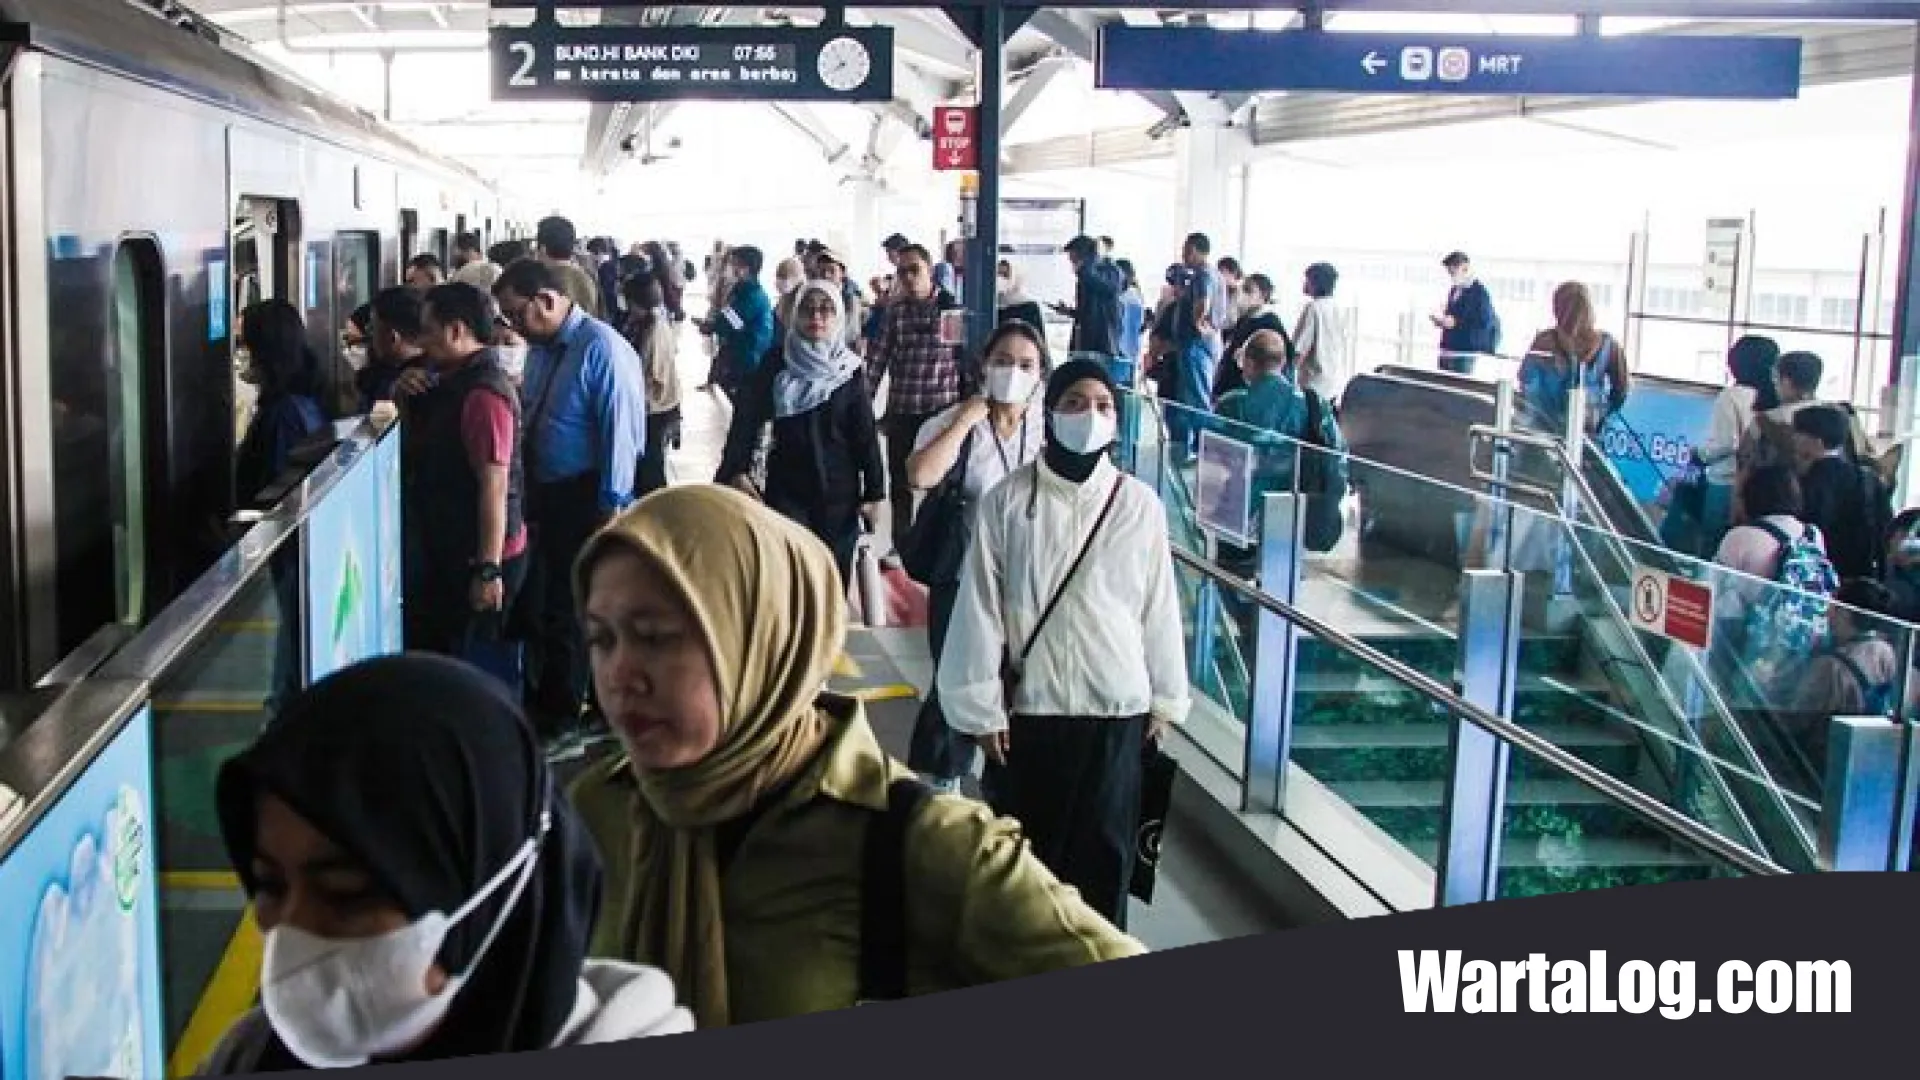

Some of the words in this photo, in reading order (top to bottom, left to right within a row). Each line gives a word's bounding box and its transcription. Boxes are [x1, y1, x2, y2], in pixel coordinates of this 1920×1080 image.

[624, 45, 667, 60] BANK
[509, 41, 537, 86] 2
[1479, 55, 1522, 74] MRT
[939, 137, 971, 149] STOP
